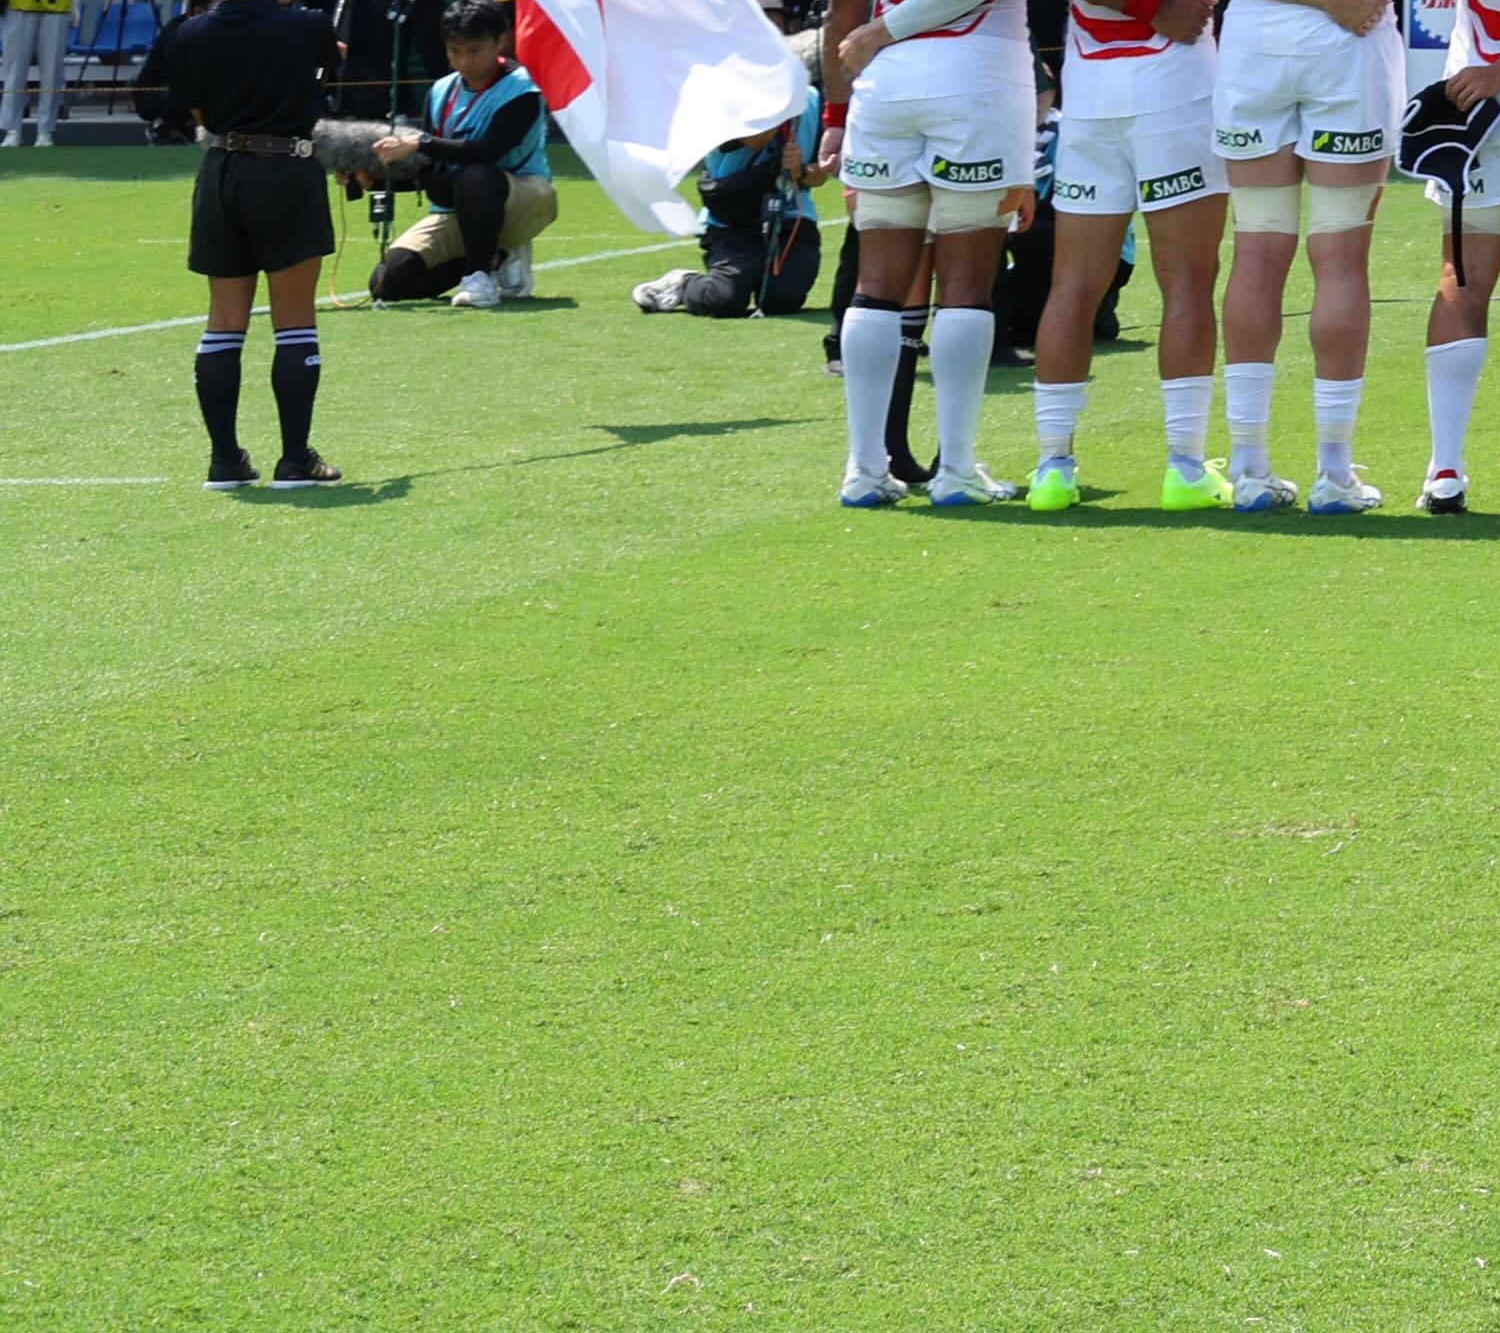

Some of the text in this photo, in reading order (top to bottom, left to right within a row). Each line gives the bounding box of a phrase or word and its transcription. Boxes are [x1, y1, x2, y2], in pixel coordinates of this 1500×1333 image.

[1216, 128, 1263, 148] SECOM
[1333, 132, 1382, 153] SMBC
[844, 158, 889, 178] SECOM
[948, 162, 1001, 182] SMBC
[1153, 171, 1204, 199] SMBC
